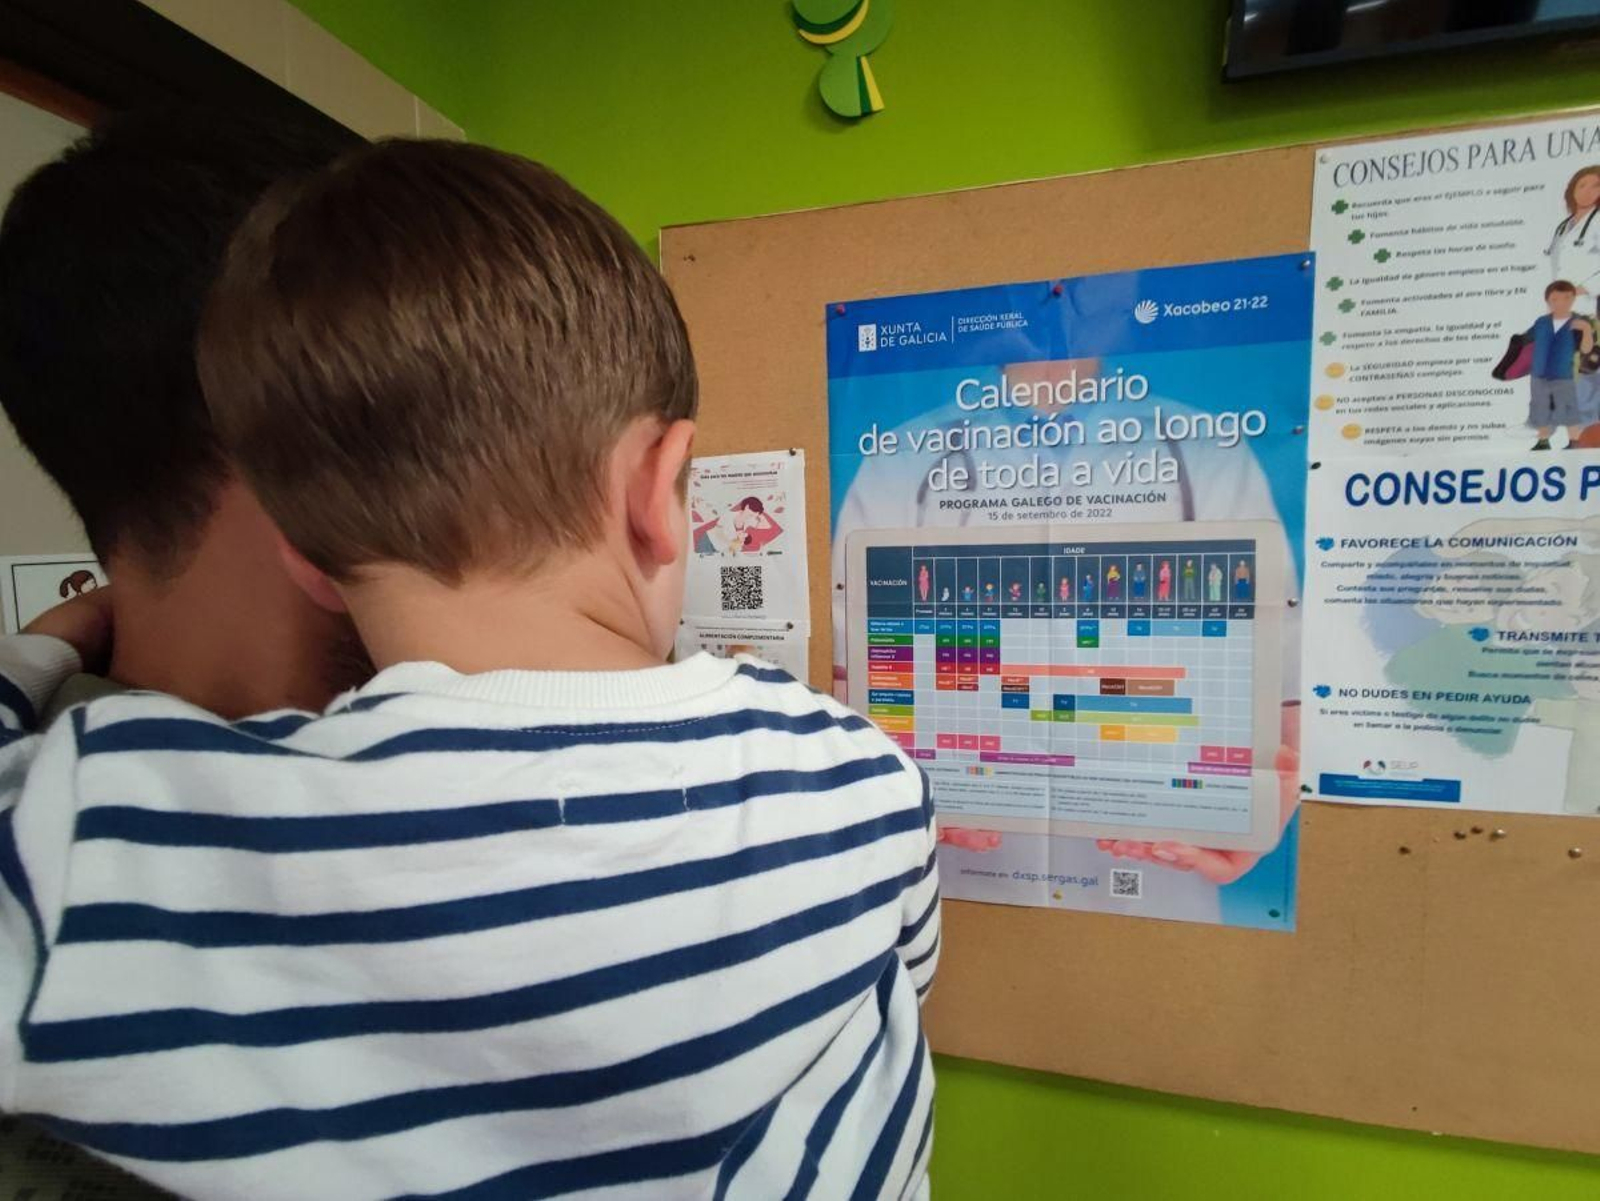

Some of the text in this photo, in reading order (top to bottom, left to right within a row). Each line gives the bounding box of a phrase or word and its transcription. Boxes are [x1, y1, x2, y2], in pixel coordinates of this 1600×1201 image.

[1333, 148, 1459, 188] CONSEJOS
[1467, 137, 1536, 169] PARA
[1394, 197, 1411, 205] que
[1163, 300, 1231, 317] Xacobeo
[880, 322, 921, 336] XUNTA
[958, 313, 998, 325] DIRECCIÓN
[880, 336, 895, 348] DE
[899, 332, 948, 346] GALICIA
[954, 367, 1149, 412] Calendario
[859, 405, 1267, 456] de vacinación ao longo
[928, 448, 1180, 493] de toda a vida
[1345, 466, 1566, 507] CONSEJOS
[939, 490, 1167, 509] PROGRAMA GALEGO DE VACINACIÓN
[987, 507, 1112, 520] 15 de setembro de 2022
[1341, 535, 1578, 549] FAVORECE LA COMUNICACIÓN
[1496, 631, 1589, 643] TRANSMITE
[1339, 688, 1532, 704] NO DUDES EN PEDIR AYUDA
[1012, 870, 1099, 887] dxsp.sergas.gal
